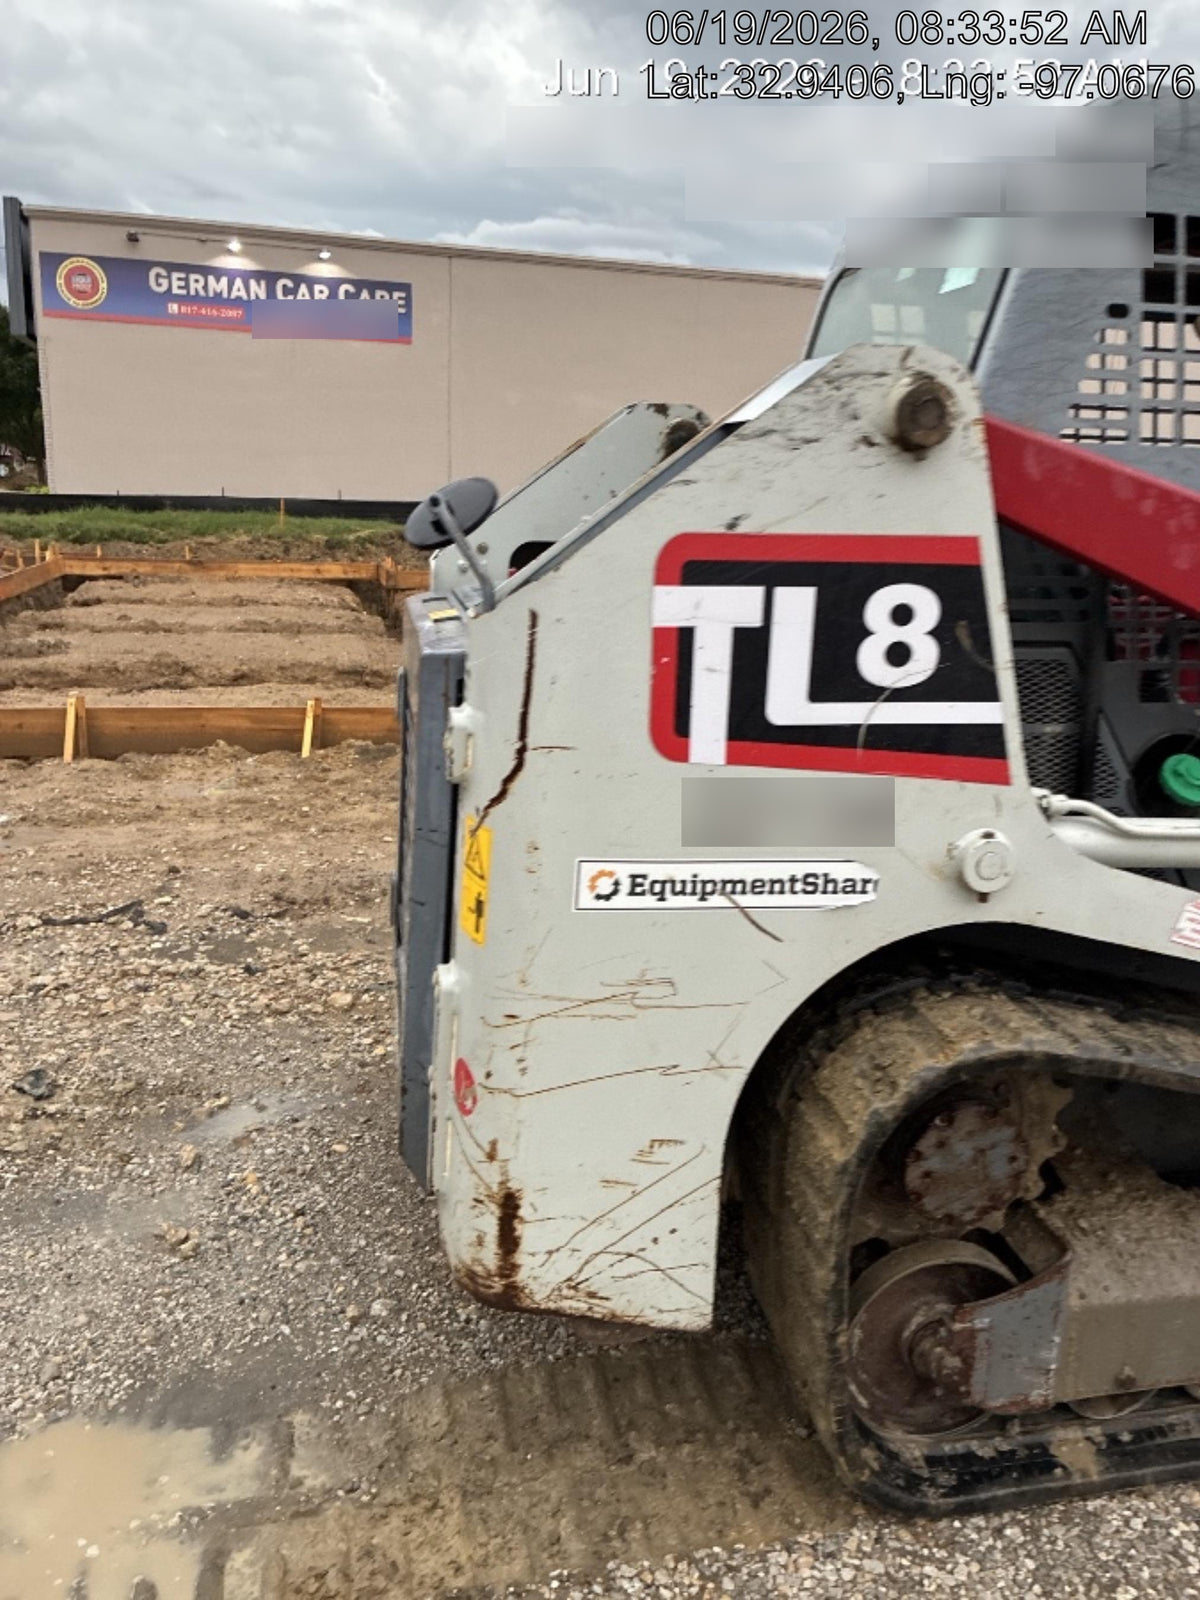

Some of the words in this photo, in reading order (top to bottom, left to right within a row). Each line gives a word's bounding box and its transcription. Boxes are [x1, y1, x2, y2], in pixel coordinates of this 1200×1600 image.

[149, 267, 267, 301] GERMAN
[275, 278, 330, 300] CAR
[651, 583, 1004, 765] TL8
[627, 872, 879, 901] EquipmentShar
